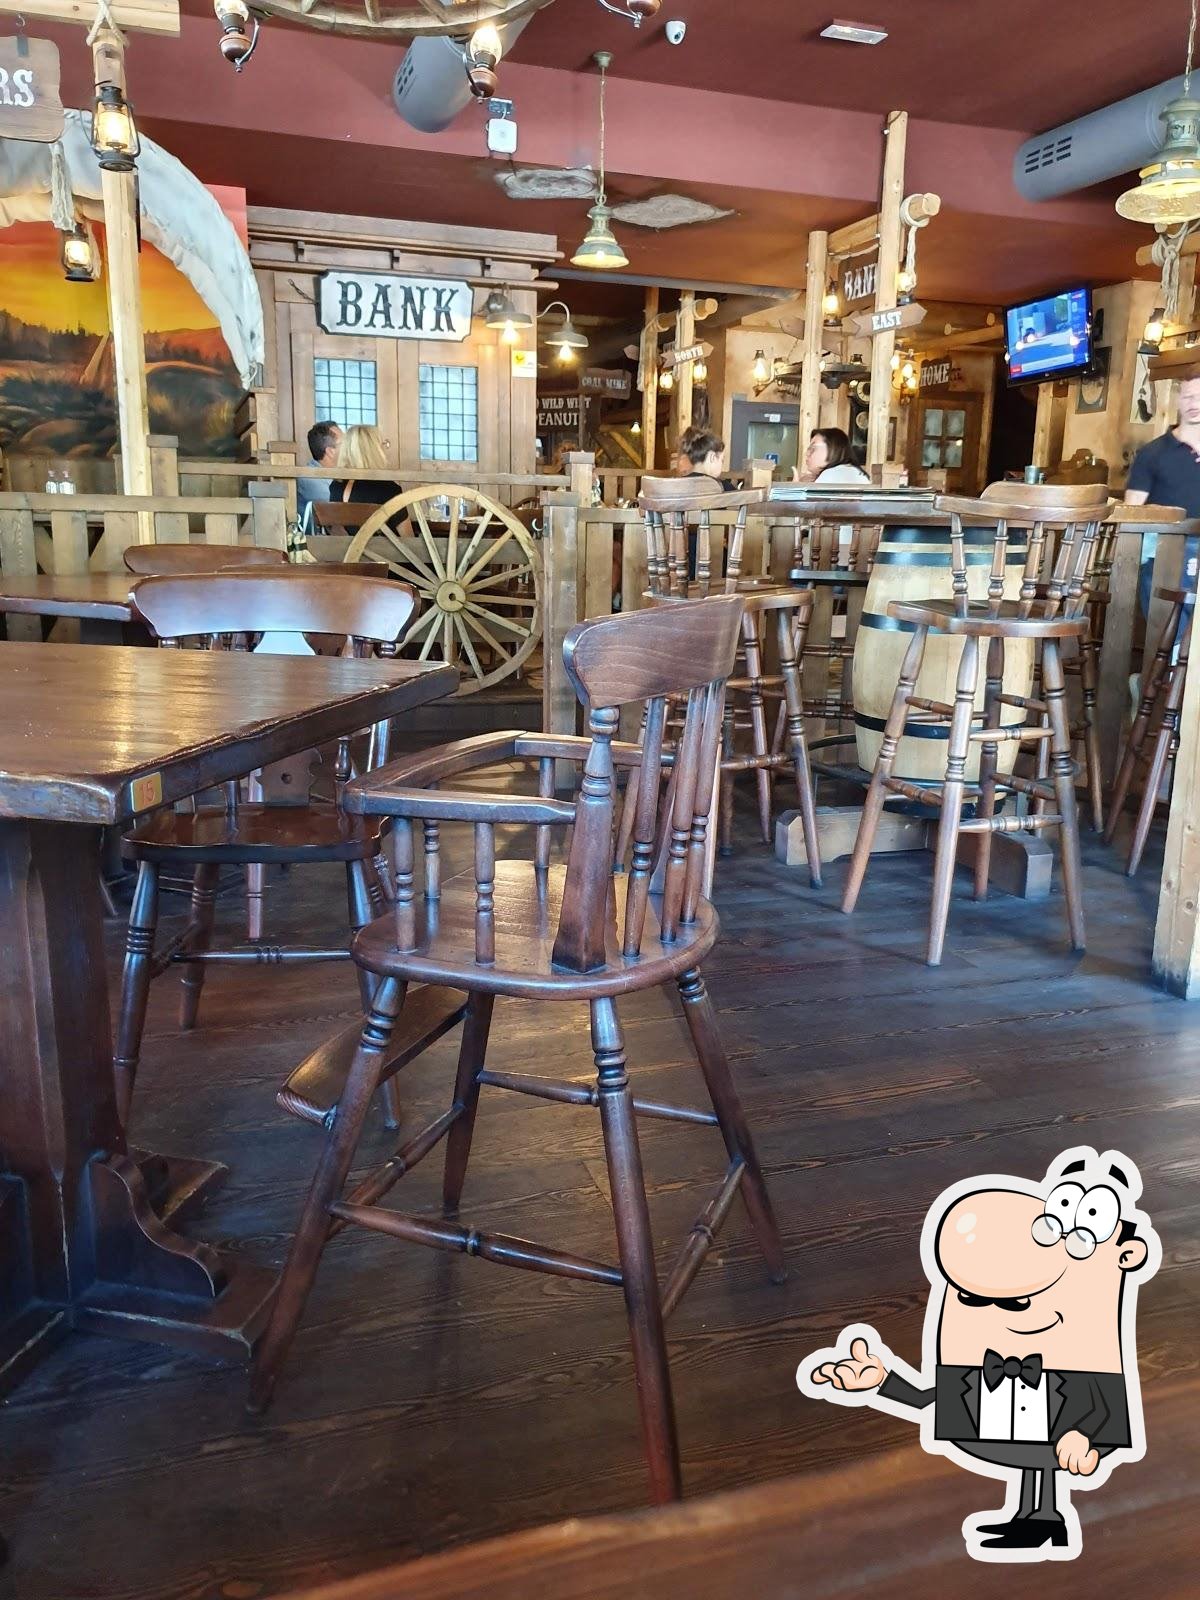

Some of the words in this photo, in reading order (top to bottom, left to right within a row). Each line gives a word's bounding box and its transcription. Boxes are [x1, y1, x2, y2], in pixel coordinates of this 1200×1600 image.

[843, 262, 878, 301] BAN
[336, 280, 459, 332] BANK
[871, 310, 902, 331] EAST
[920, 362, 951, 387] HOME
[541, 398, 565, 409] WILD
[536, 412, 579, 426] EANUT
